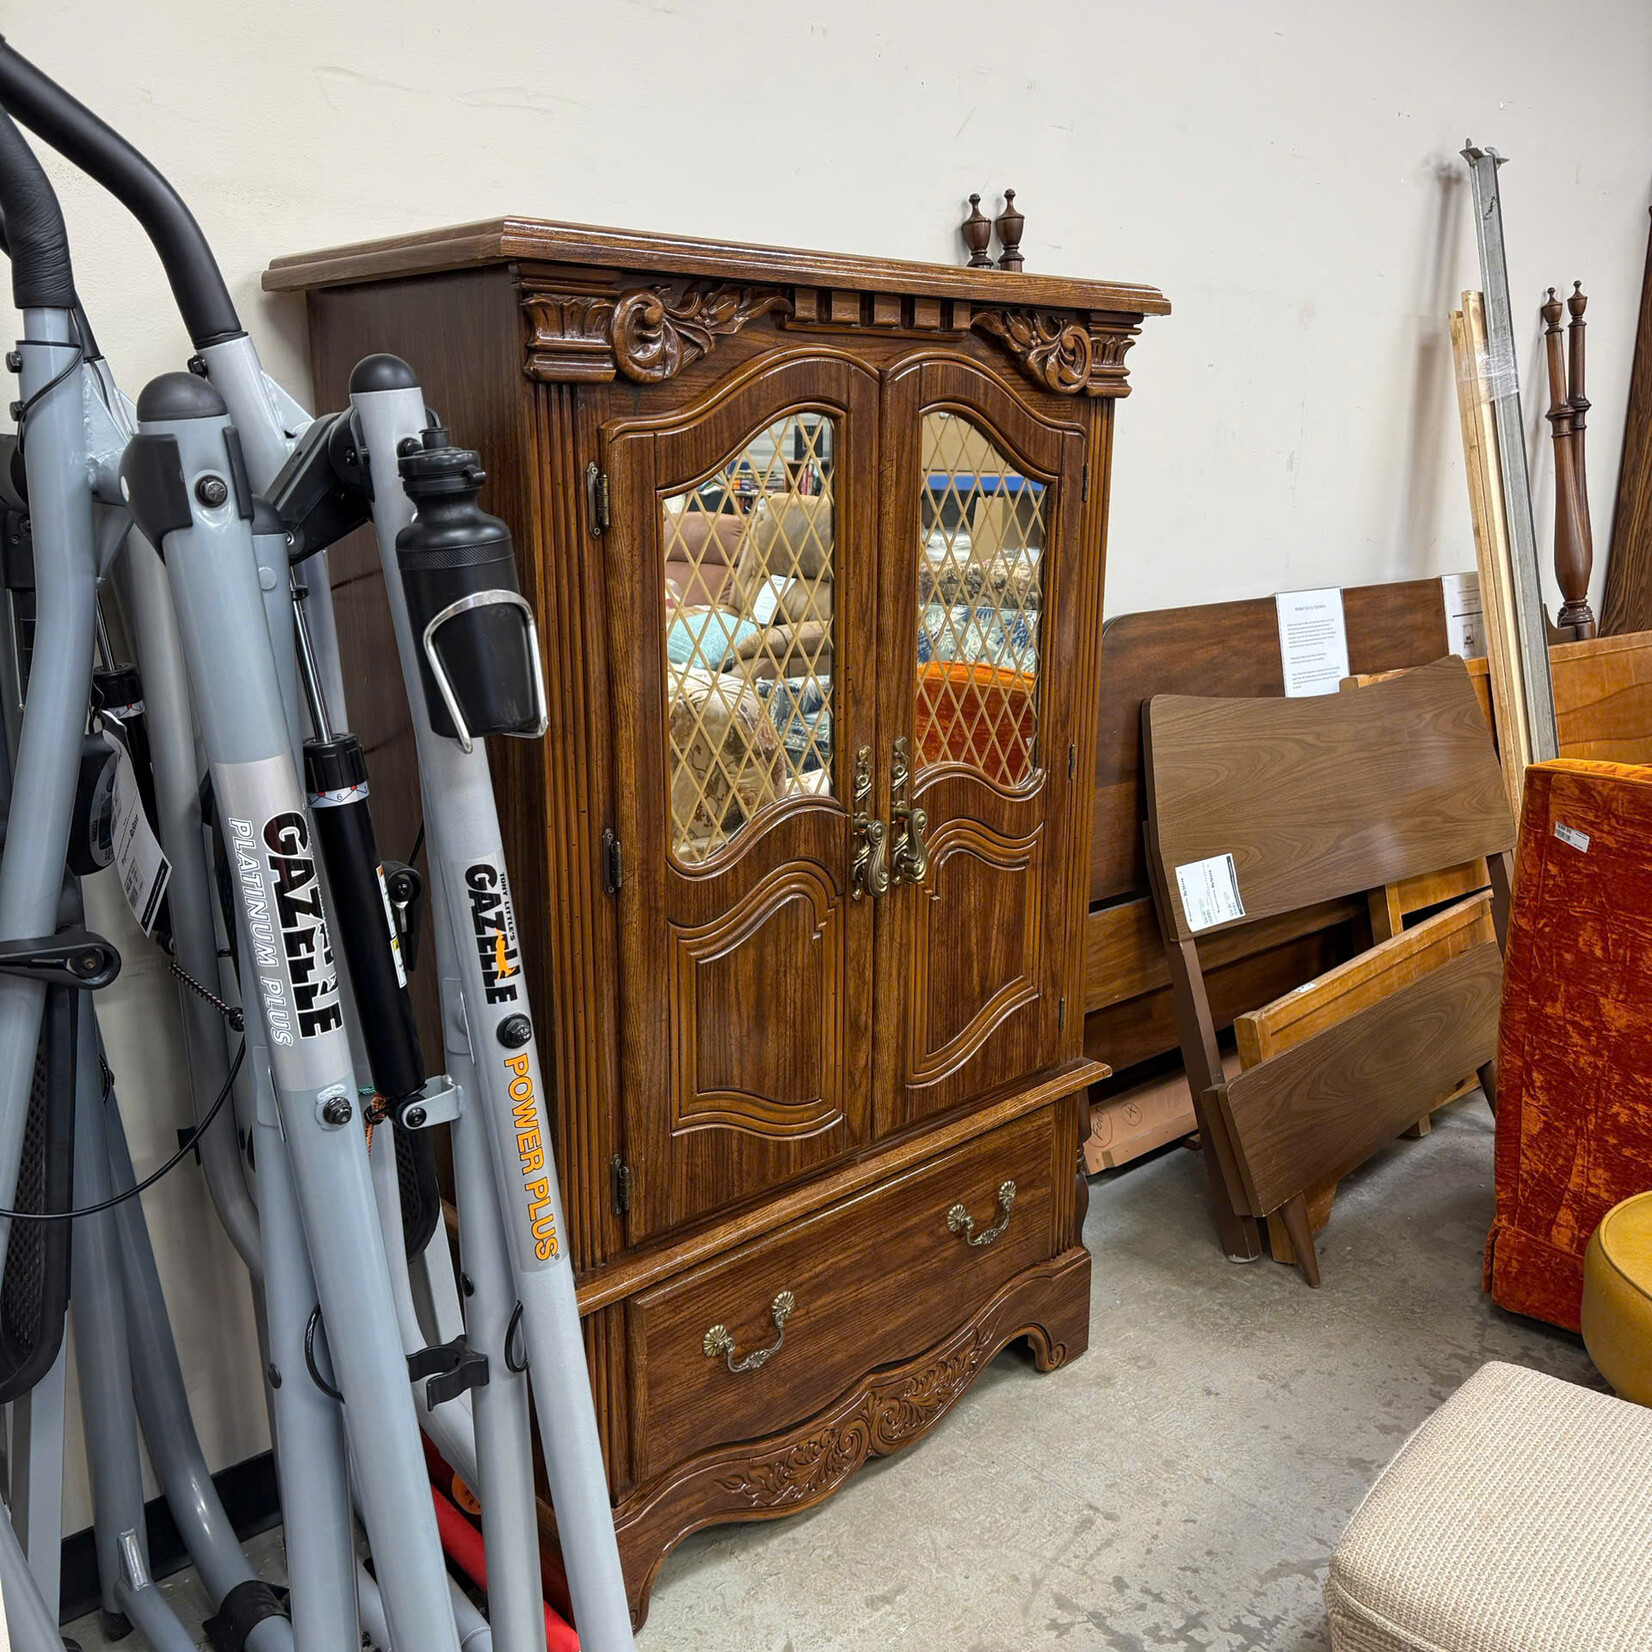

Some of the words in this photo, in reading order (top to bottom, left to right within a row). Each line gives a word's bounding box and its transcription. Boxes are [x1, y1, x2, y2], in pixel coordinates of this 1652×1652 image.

[336, 793, 343, 801] 6
[229, 817, 279, 968] PLATINUM
[260, 975, 294, 1047] PLUS
[261, 810, 343, 1039] GAZELLE
[465, 863, 521, 1005] GAZELLE
[499, 872, 509, 896] TONY
[504, 900, 516, 941] LITTLE'S
[504, 1052, 545, 1176] POWER
